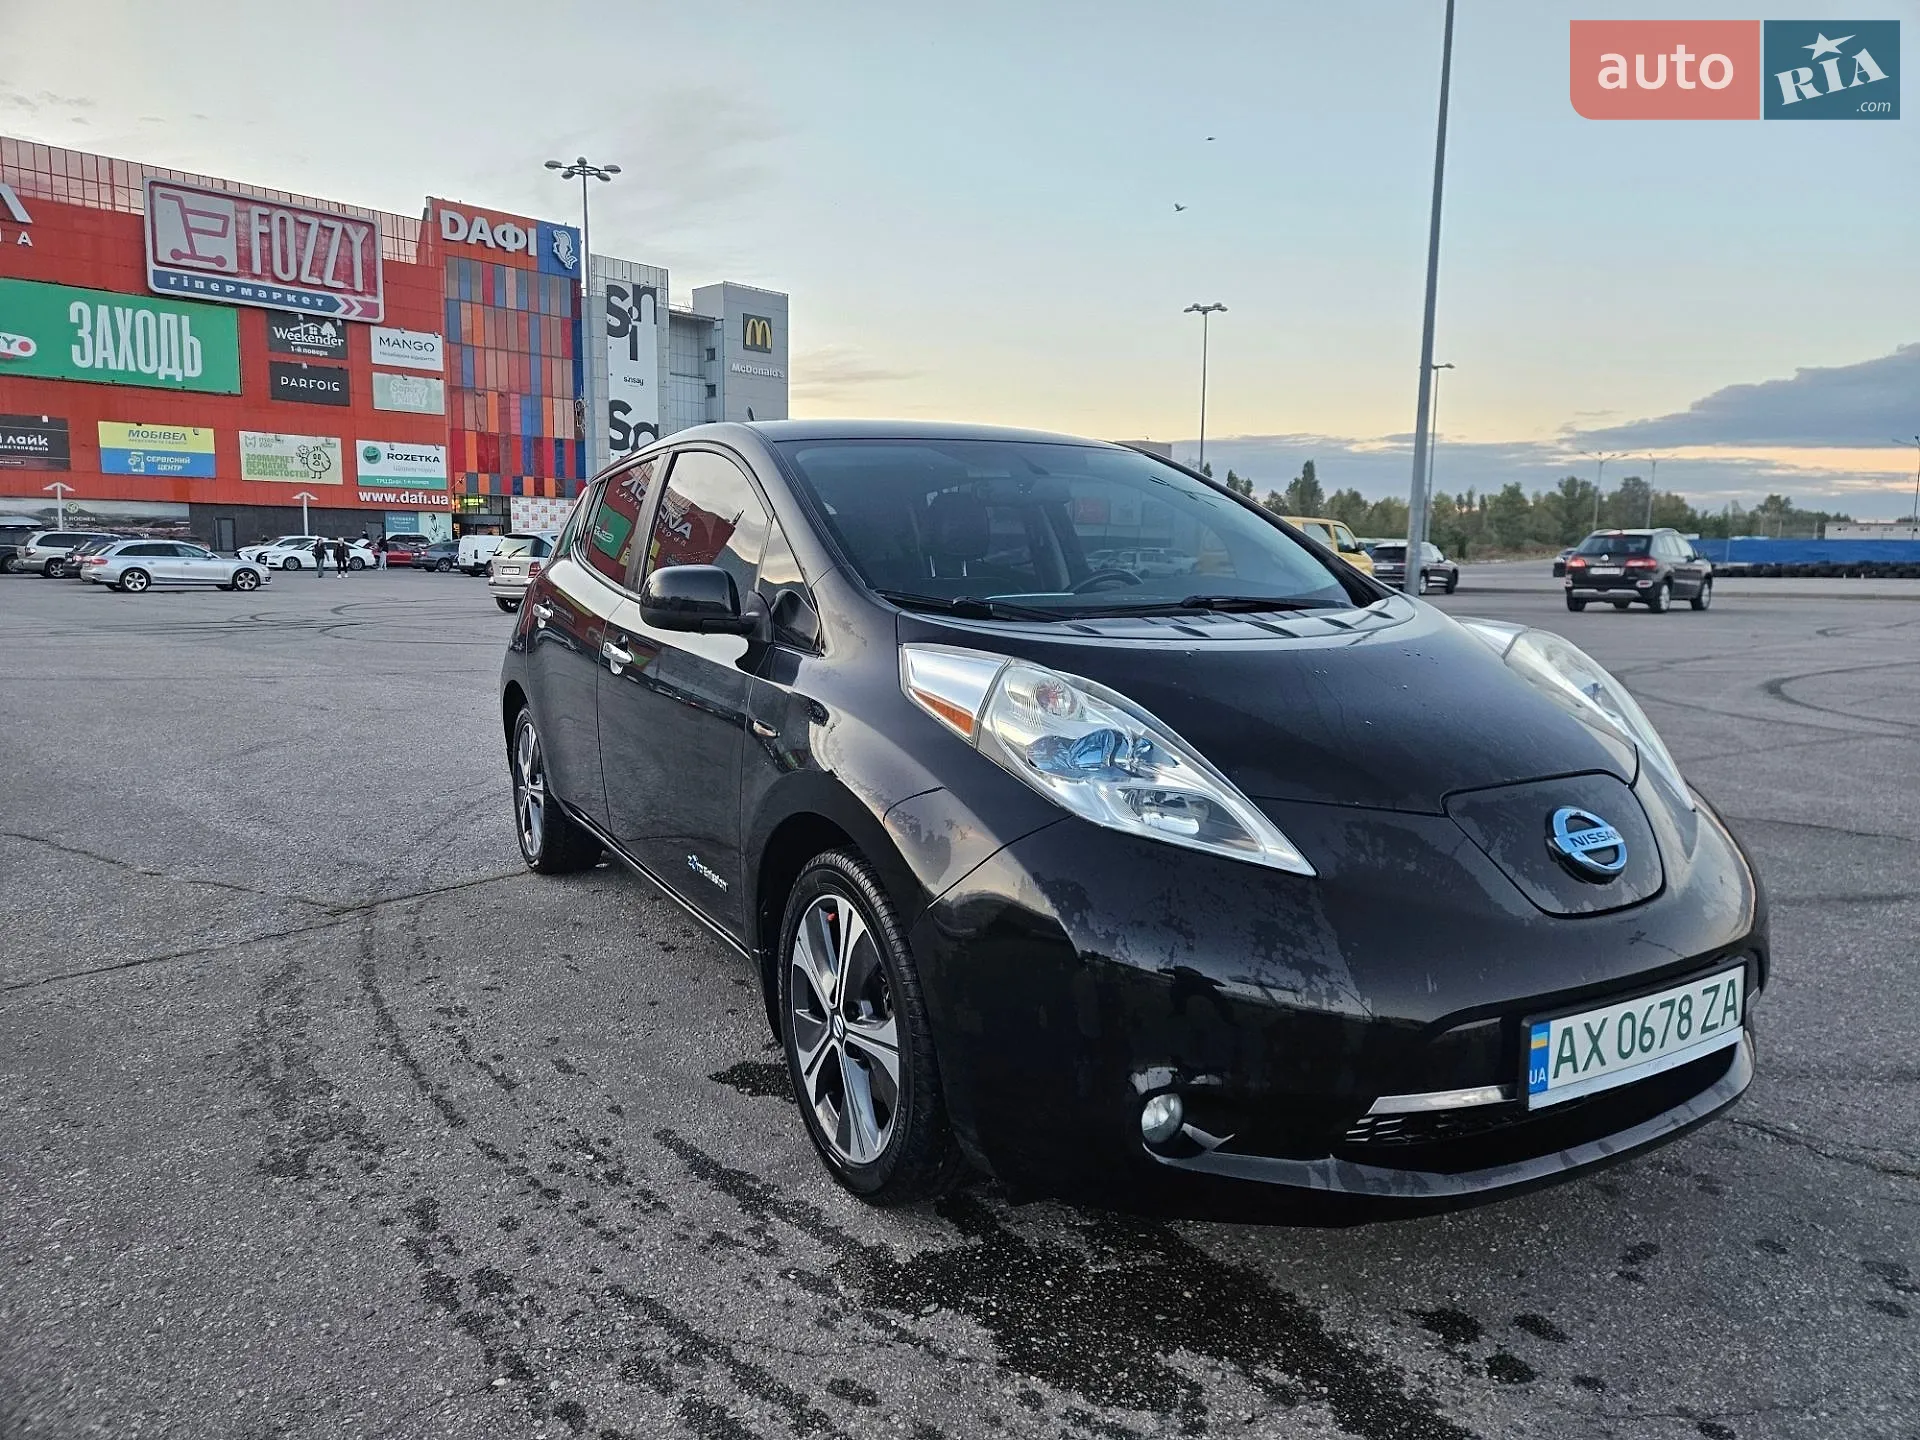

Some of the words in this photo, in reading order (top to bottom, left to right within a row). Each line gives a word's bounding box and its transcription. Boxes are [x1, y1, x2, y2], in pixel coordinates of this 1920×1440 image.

[249, 205, 370, 292] FOZZY
[168, 275, 325, 307] гіпермаркет
[69, 301, 203, 382] ЗАХОДЬ
[272, 323, 344, 346] Weekender
[379, 335, 435, 353] MANGO
[731, 362, 785, 378] McDonald's
[280, 376, 340, 392] PARFOIS
[146, 455, 191, 464] СЕРВІСНИЙ
[387, 452, 440, 463] ROZETKA
[157, 463, 183, 472] ЦЕНТР
[358, 491, 448, 505] www.dafi.ua
[1569, 828, 1620, 848] NISSAN
[1529, 1070, 1547, 1085] UA
[1553, 1017, 1608, 1079] AX
[1617, 994, 1693, 1060] 0678
[1700, 978, 1739, 1035] ZA
